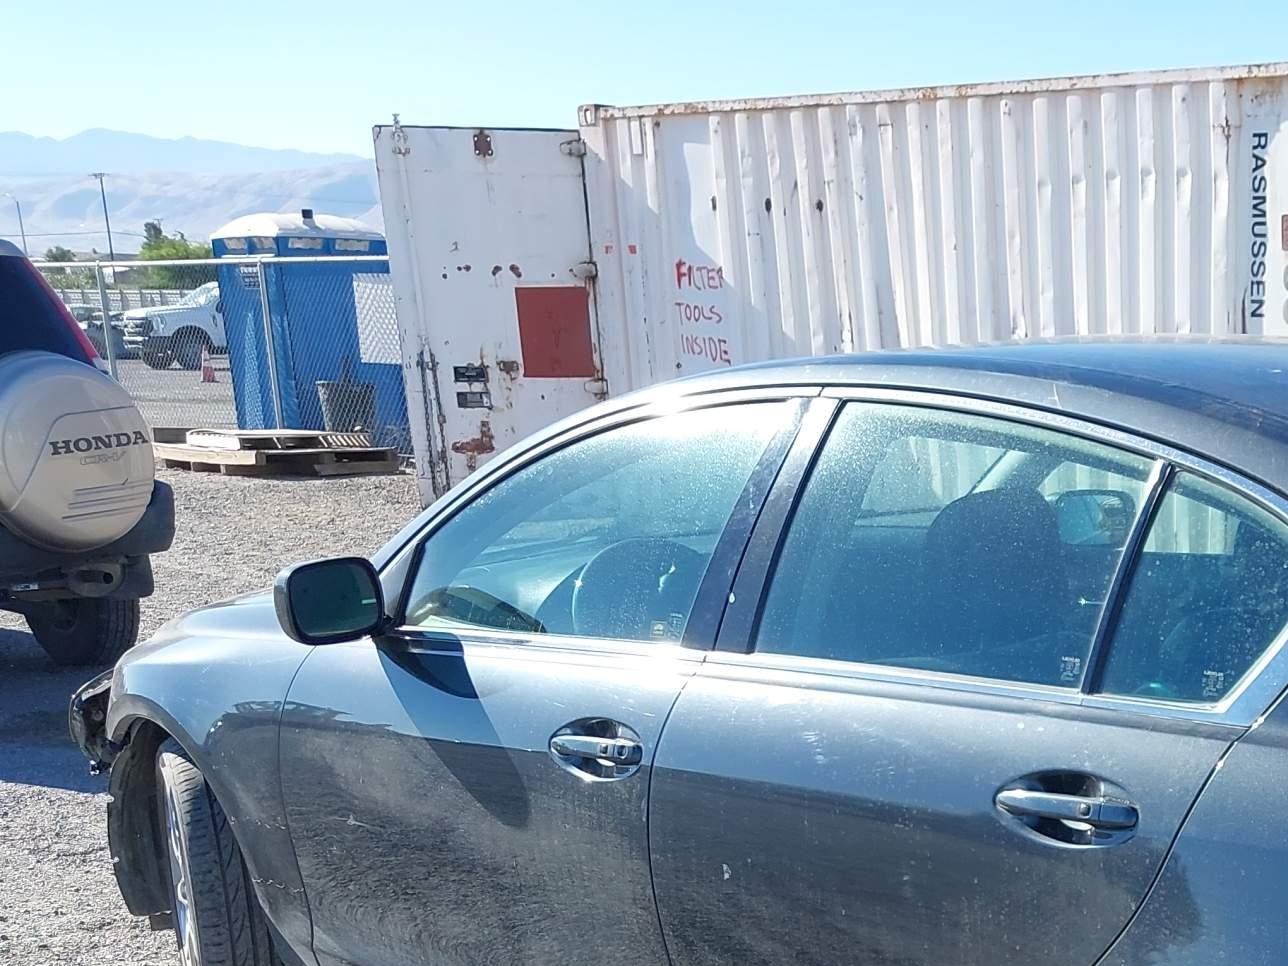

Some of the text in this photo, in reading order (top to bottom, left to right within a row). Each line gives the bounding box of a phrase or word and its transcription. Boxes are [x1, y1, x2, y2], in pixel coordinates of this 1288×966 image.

[1250, 132, 1269, 318] RASMUSSEN
[674, 302, 723, 326] TOOLS
[681, 333, 732, 366] INSIDE
[49, 431, 149, 455] HONDA
